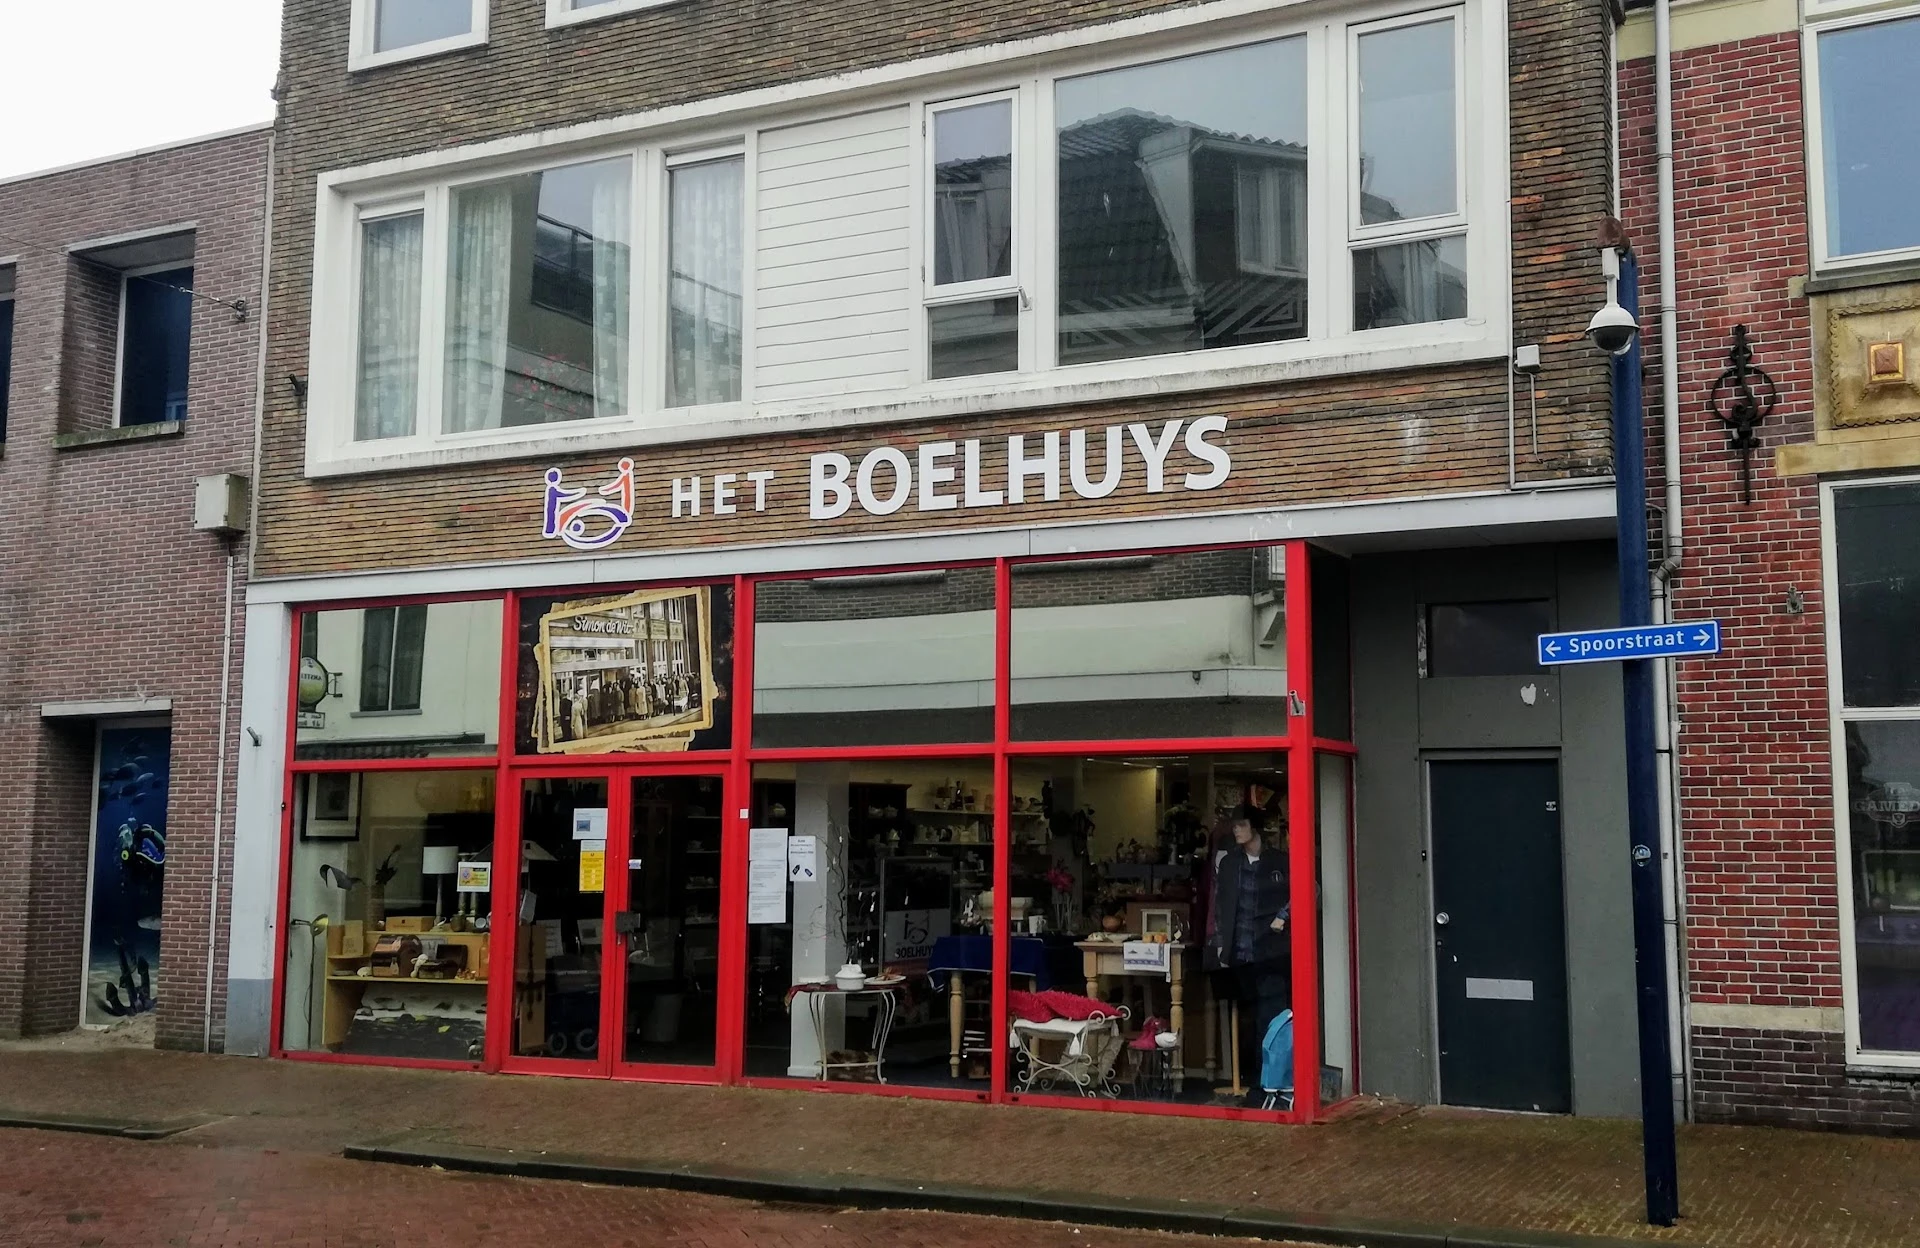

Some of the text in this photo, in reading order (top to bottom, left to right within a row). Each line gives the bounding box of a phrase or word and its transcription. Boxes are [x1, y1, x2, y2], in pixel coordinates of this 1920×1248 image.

[671, 415, 1232, 520] HET BOELHUYS
[573, 615, 606, 632] Simon
[1569, 631, 1685, 656] Spoorstraat
[895, 945, 934, 958] BOELHUY
